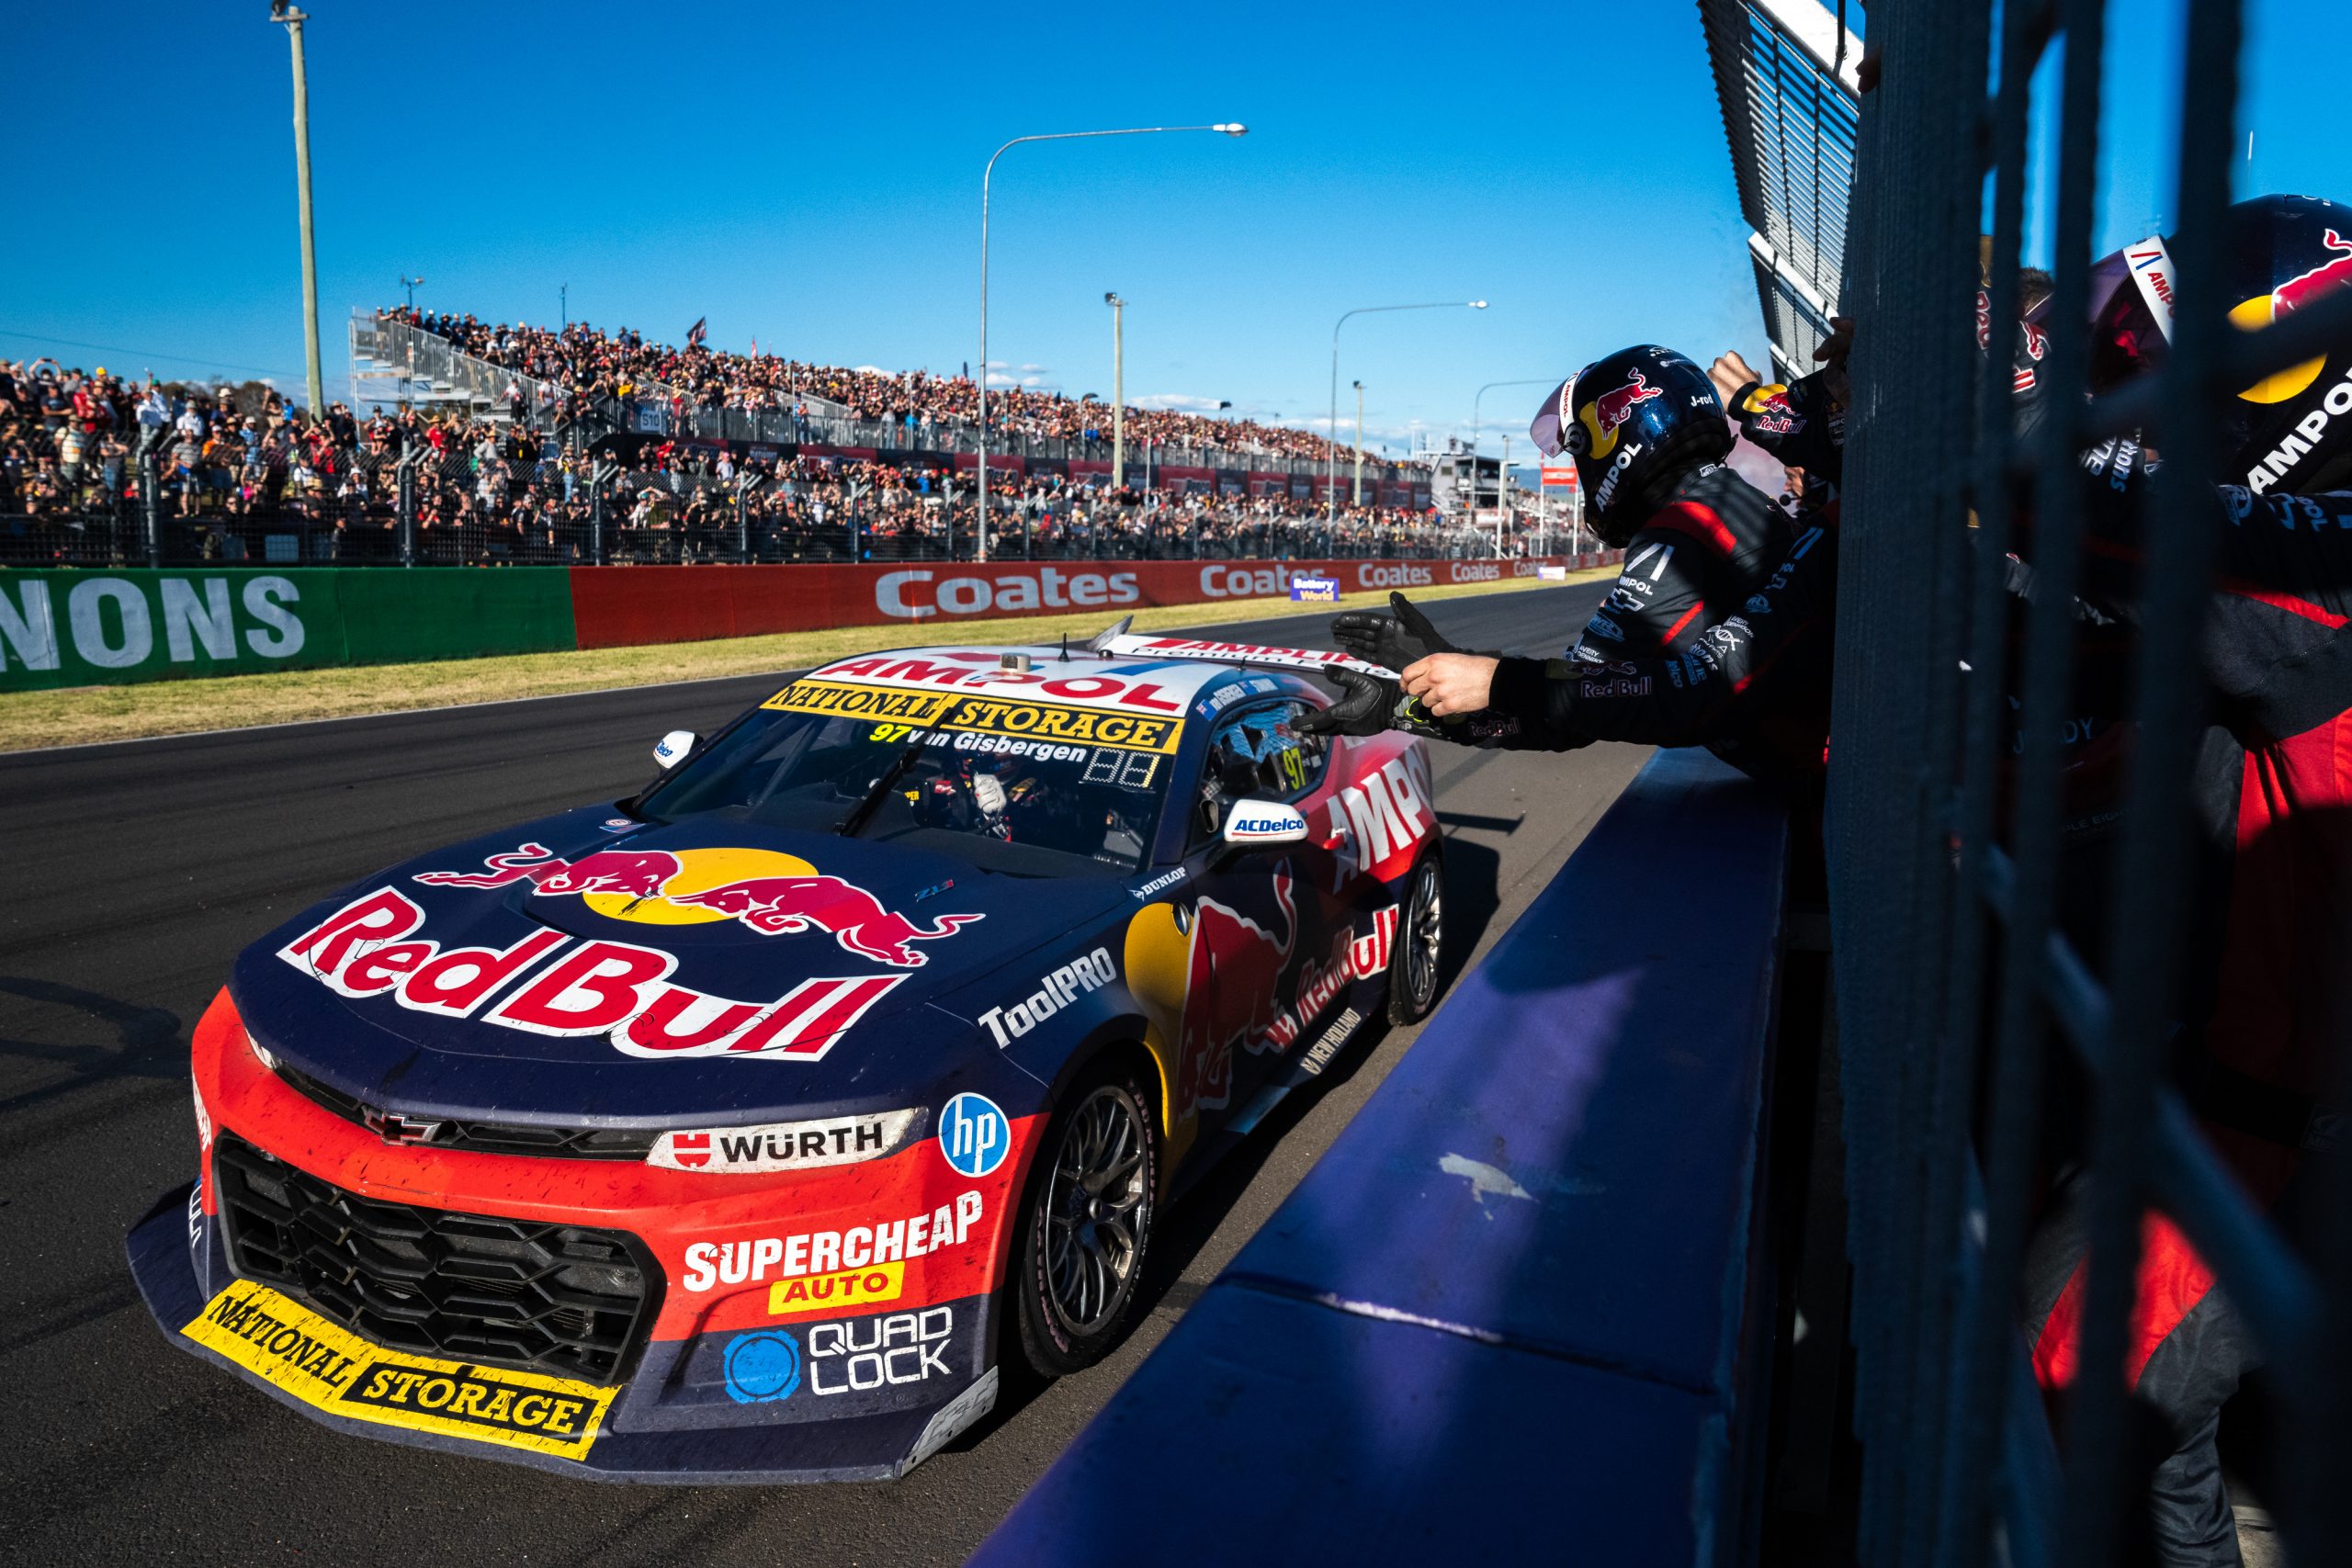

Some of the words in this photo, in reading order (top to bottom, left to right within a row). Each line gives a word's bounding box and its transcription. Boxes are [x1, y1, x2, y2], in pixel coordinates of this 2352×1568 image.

[1562, 383, 1571, 418] AMPOL
[1595, 441, 1643, 513] AMPOL
[875, 567, 1140, 618] Coates
[1294, 579, 1334, 592] Battery
[1358, 562, 1431, 587] Coates
[1451, 561, 1500, 582] Coates
[1300, 591, 1334, 601] World
[1132, 647, 1282, 664] Premium
[1180, 641, 1378, 668] AMPLIF
[817, 659, 1181, 712] AMPOL
[1580, 679, 1615, 698] Red
[1617, 676, 1652, 696] Bull
[772, 684, 946, 719] NATIONAL
[953, 701, 1167, 748] STORAGE
[869, 723, 911, 743] 97
[954, 732, 1087, 762] Gisbergen
[1283, 747, 1306, 790] 97
[1235, 817, 1304, 832] ACDelco
[1143, 866, 1186, 896] DUNLOP
[276, 886, 571, 1018] Red
[481, 938, 912, 1061] Bull
[1295, 931, 1346, 1028] Red
[1338, 904, 1399, 985] Bull
[978, 946, 1117, 1050] ToolPRO
[1307, 1030, 1337, 1065] NEW
[1325, 1007, 1362, 1052] HOLLAND
[719, 1123, 883, 1163] WÜRTH
[952, 1096, 997, 1174] hp
[683, 1190, 983, 1292] SUPERCHEAP
[782, 1272, 889, 1303] AUTO
[808, 1307, 952, 1357] QUAD
[207, 1294, 356, 1386] NATIONAL
[364, 1369, 582, 1434] STORAGE
[810, 1339, 953, 1395] LOCK
